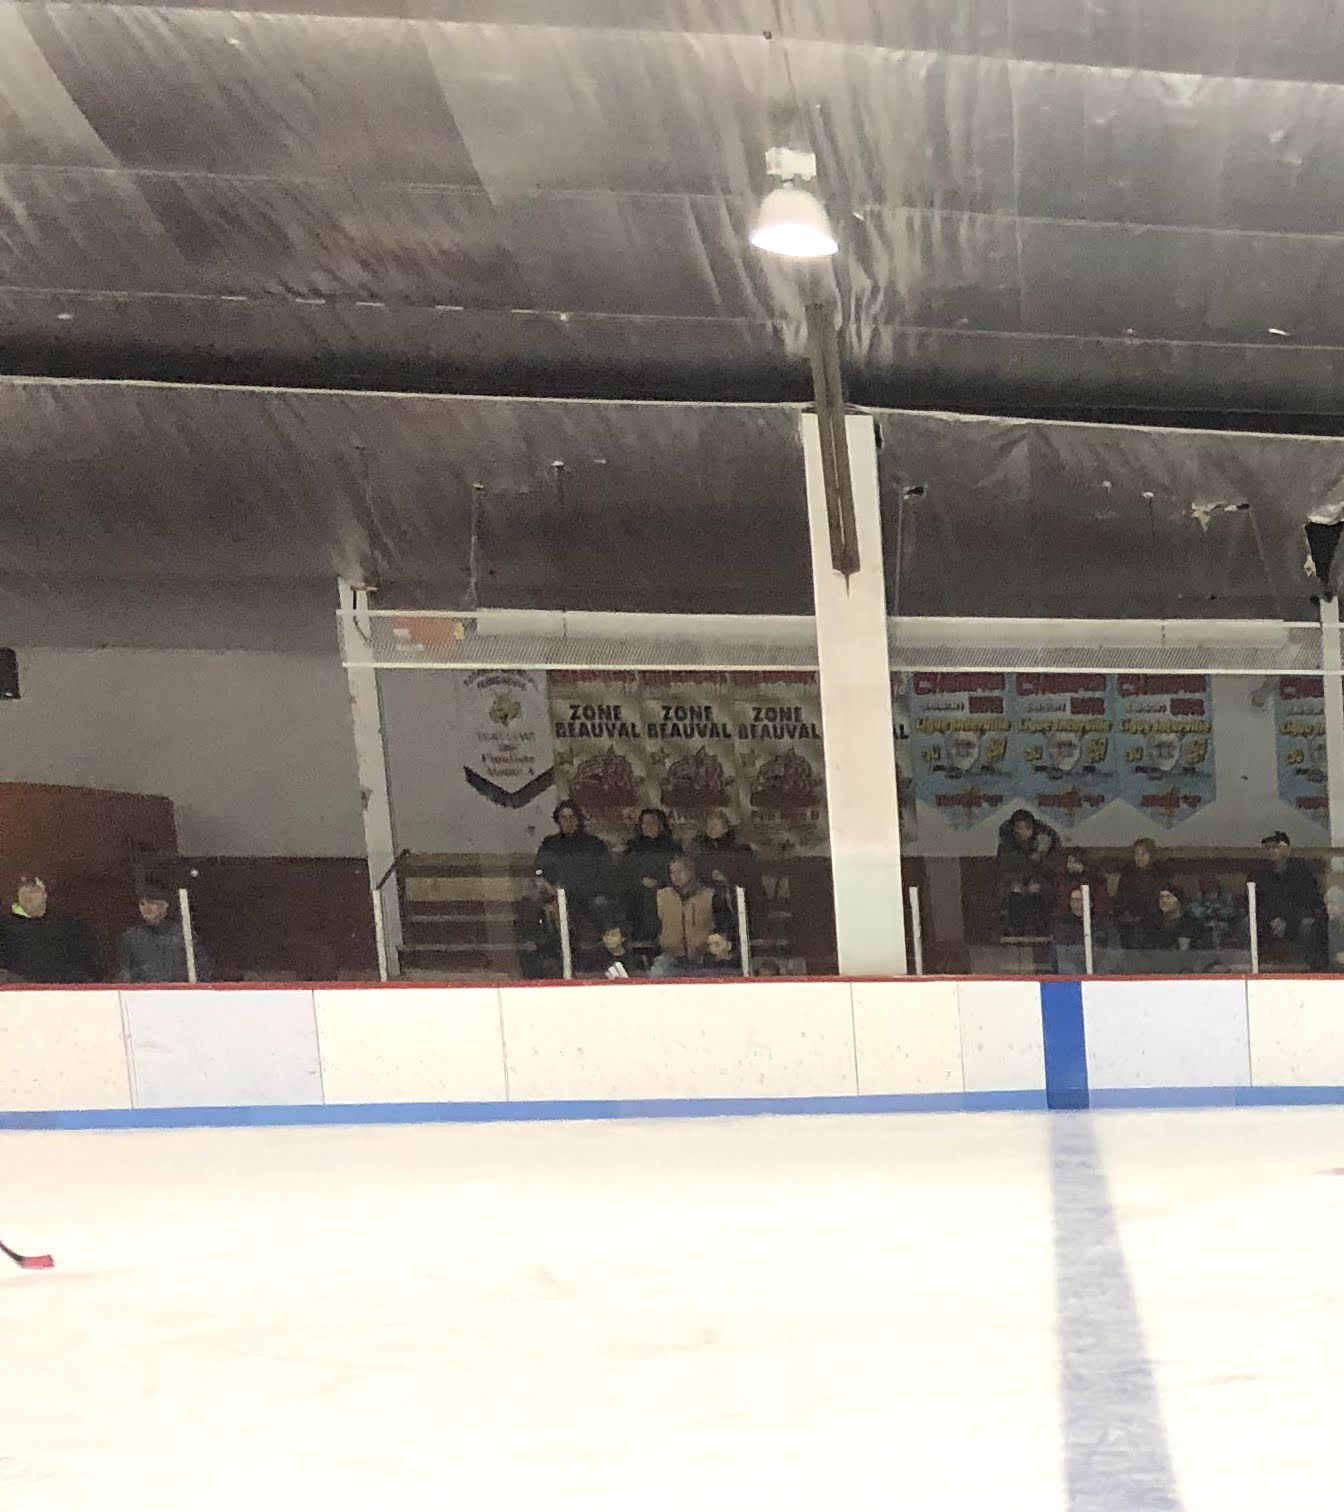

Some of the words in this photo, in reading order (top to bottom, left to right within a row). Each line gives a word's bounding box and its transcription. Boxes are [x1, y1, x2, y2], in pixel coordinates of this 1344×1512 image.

[569, 704, 623, 722] ZONE
[661, 704, 713, 722] ZONE
[752, 706, 803, 723] ZONE
[555, 721, 641, 739] BEAUVAL
[647, 722, 732, 739] BEAUVAL
[738, 723, 821, 740] BEAUVAL
